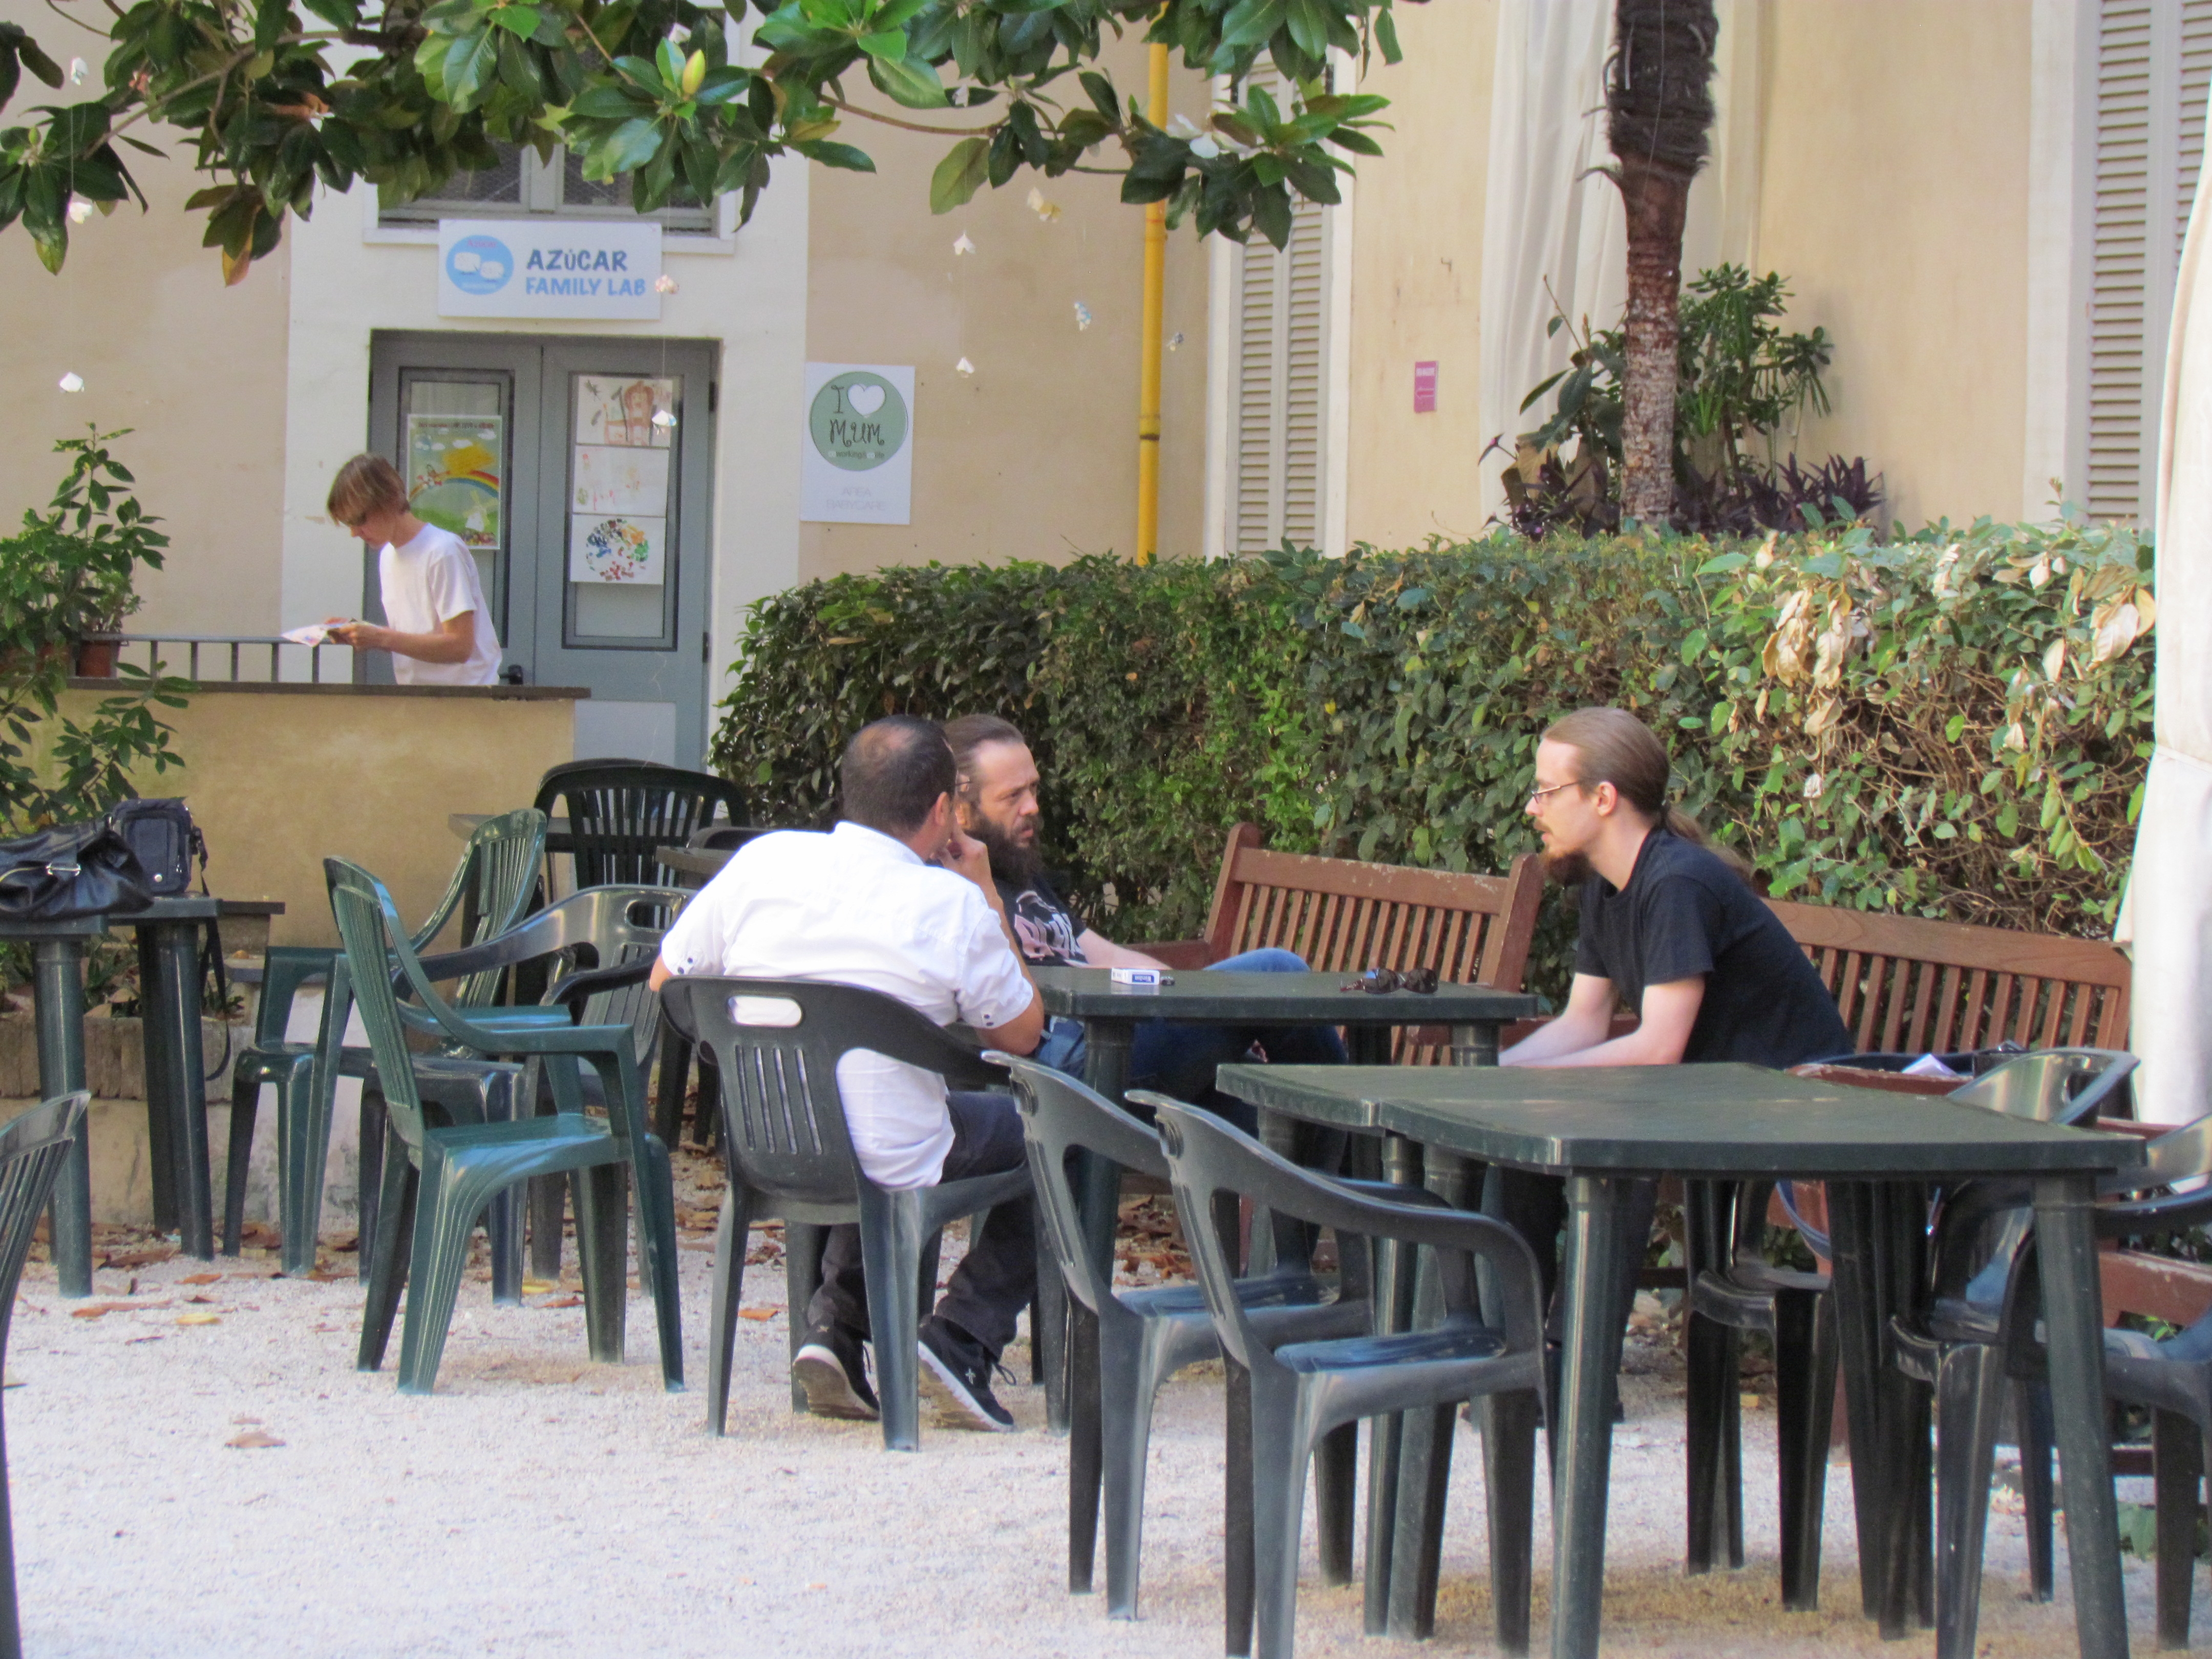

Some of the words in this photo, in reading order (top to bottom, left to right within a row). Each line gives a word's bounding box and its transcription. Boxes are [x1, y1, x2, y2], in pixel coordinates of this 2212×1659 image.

[526, 248, 628, 271] AZÚCAR
[526, 277, 602, 295] FAMILY
[608, 278, 646, 296] LAB
[831, 385, 844, 414] I
